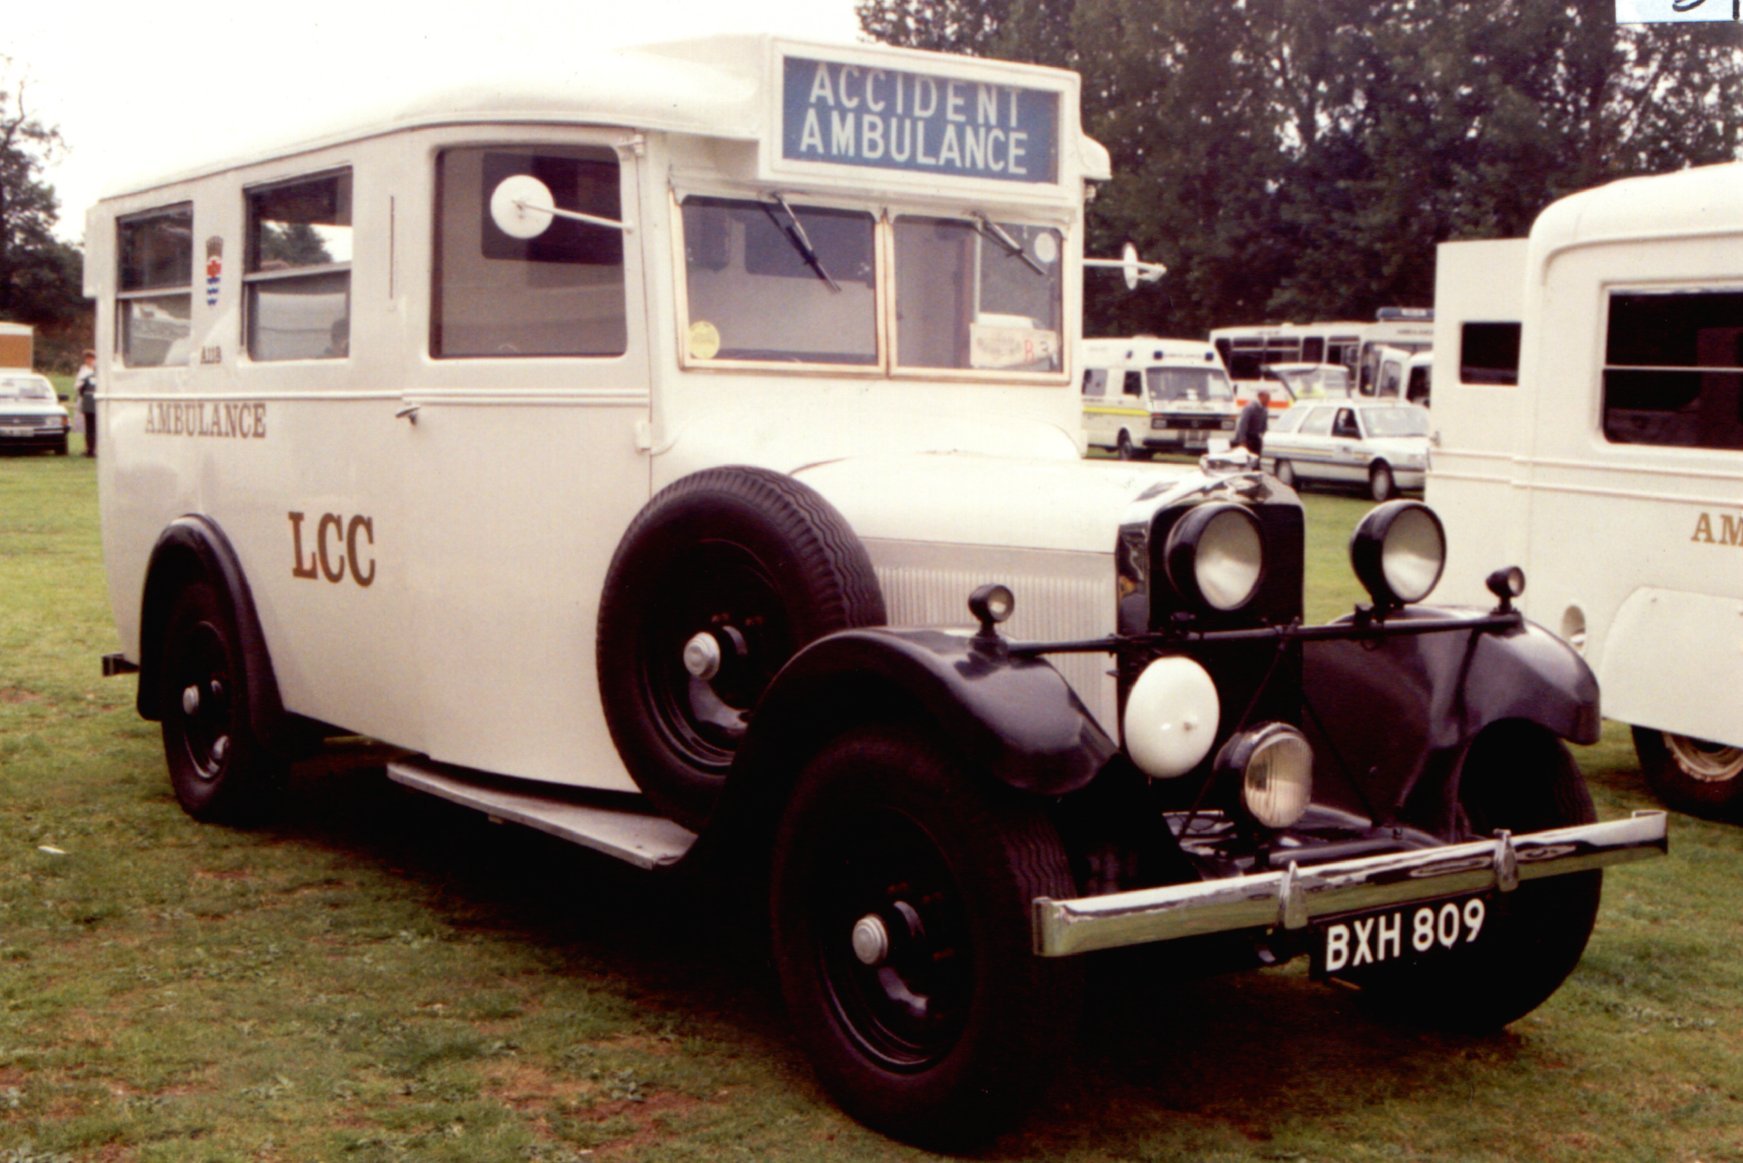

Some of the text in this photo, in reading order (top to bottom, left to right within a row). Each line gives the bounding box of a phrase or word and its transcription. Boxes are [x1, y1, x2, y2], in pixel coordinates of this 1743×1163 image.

[809, 61, 1022, 127] ACCIDENT
[800, 107, 1028, 175] AMBULANCE
[145, 402, 266, 438] AMBULANCE
[288, 511, 376, 587] LCC
[1326, 899, 1485, 972] BXH 809
